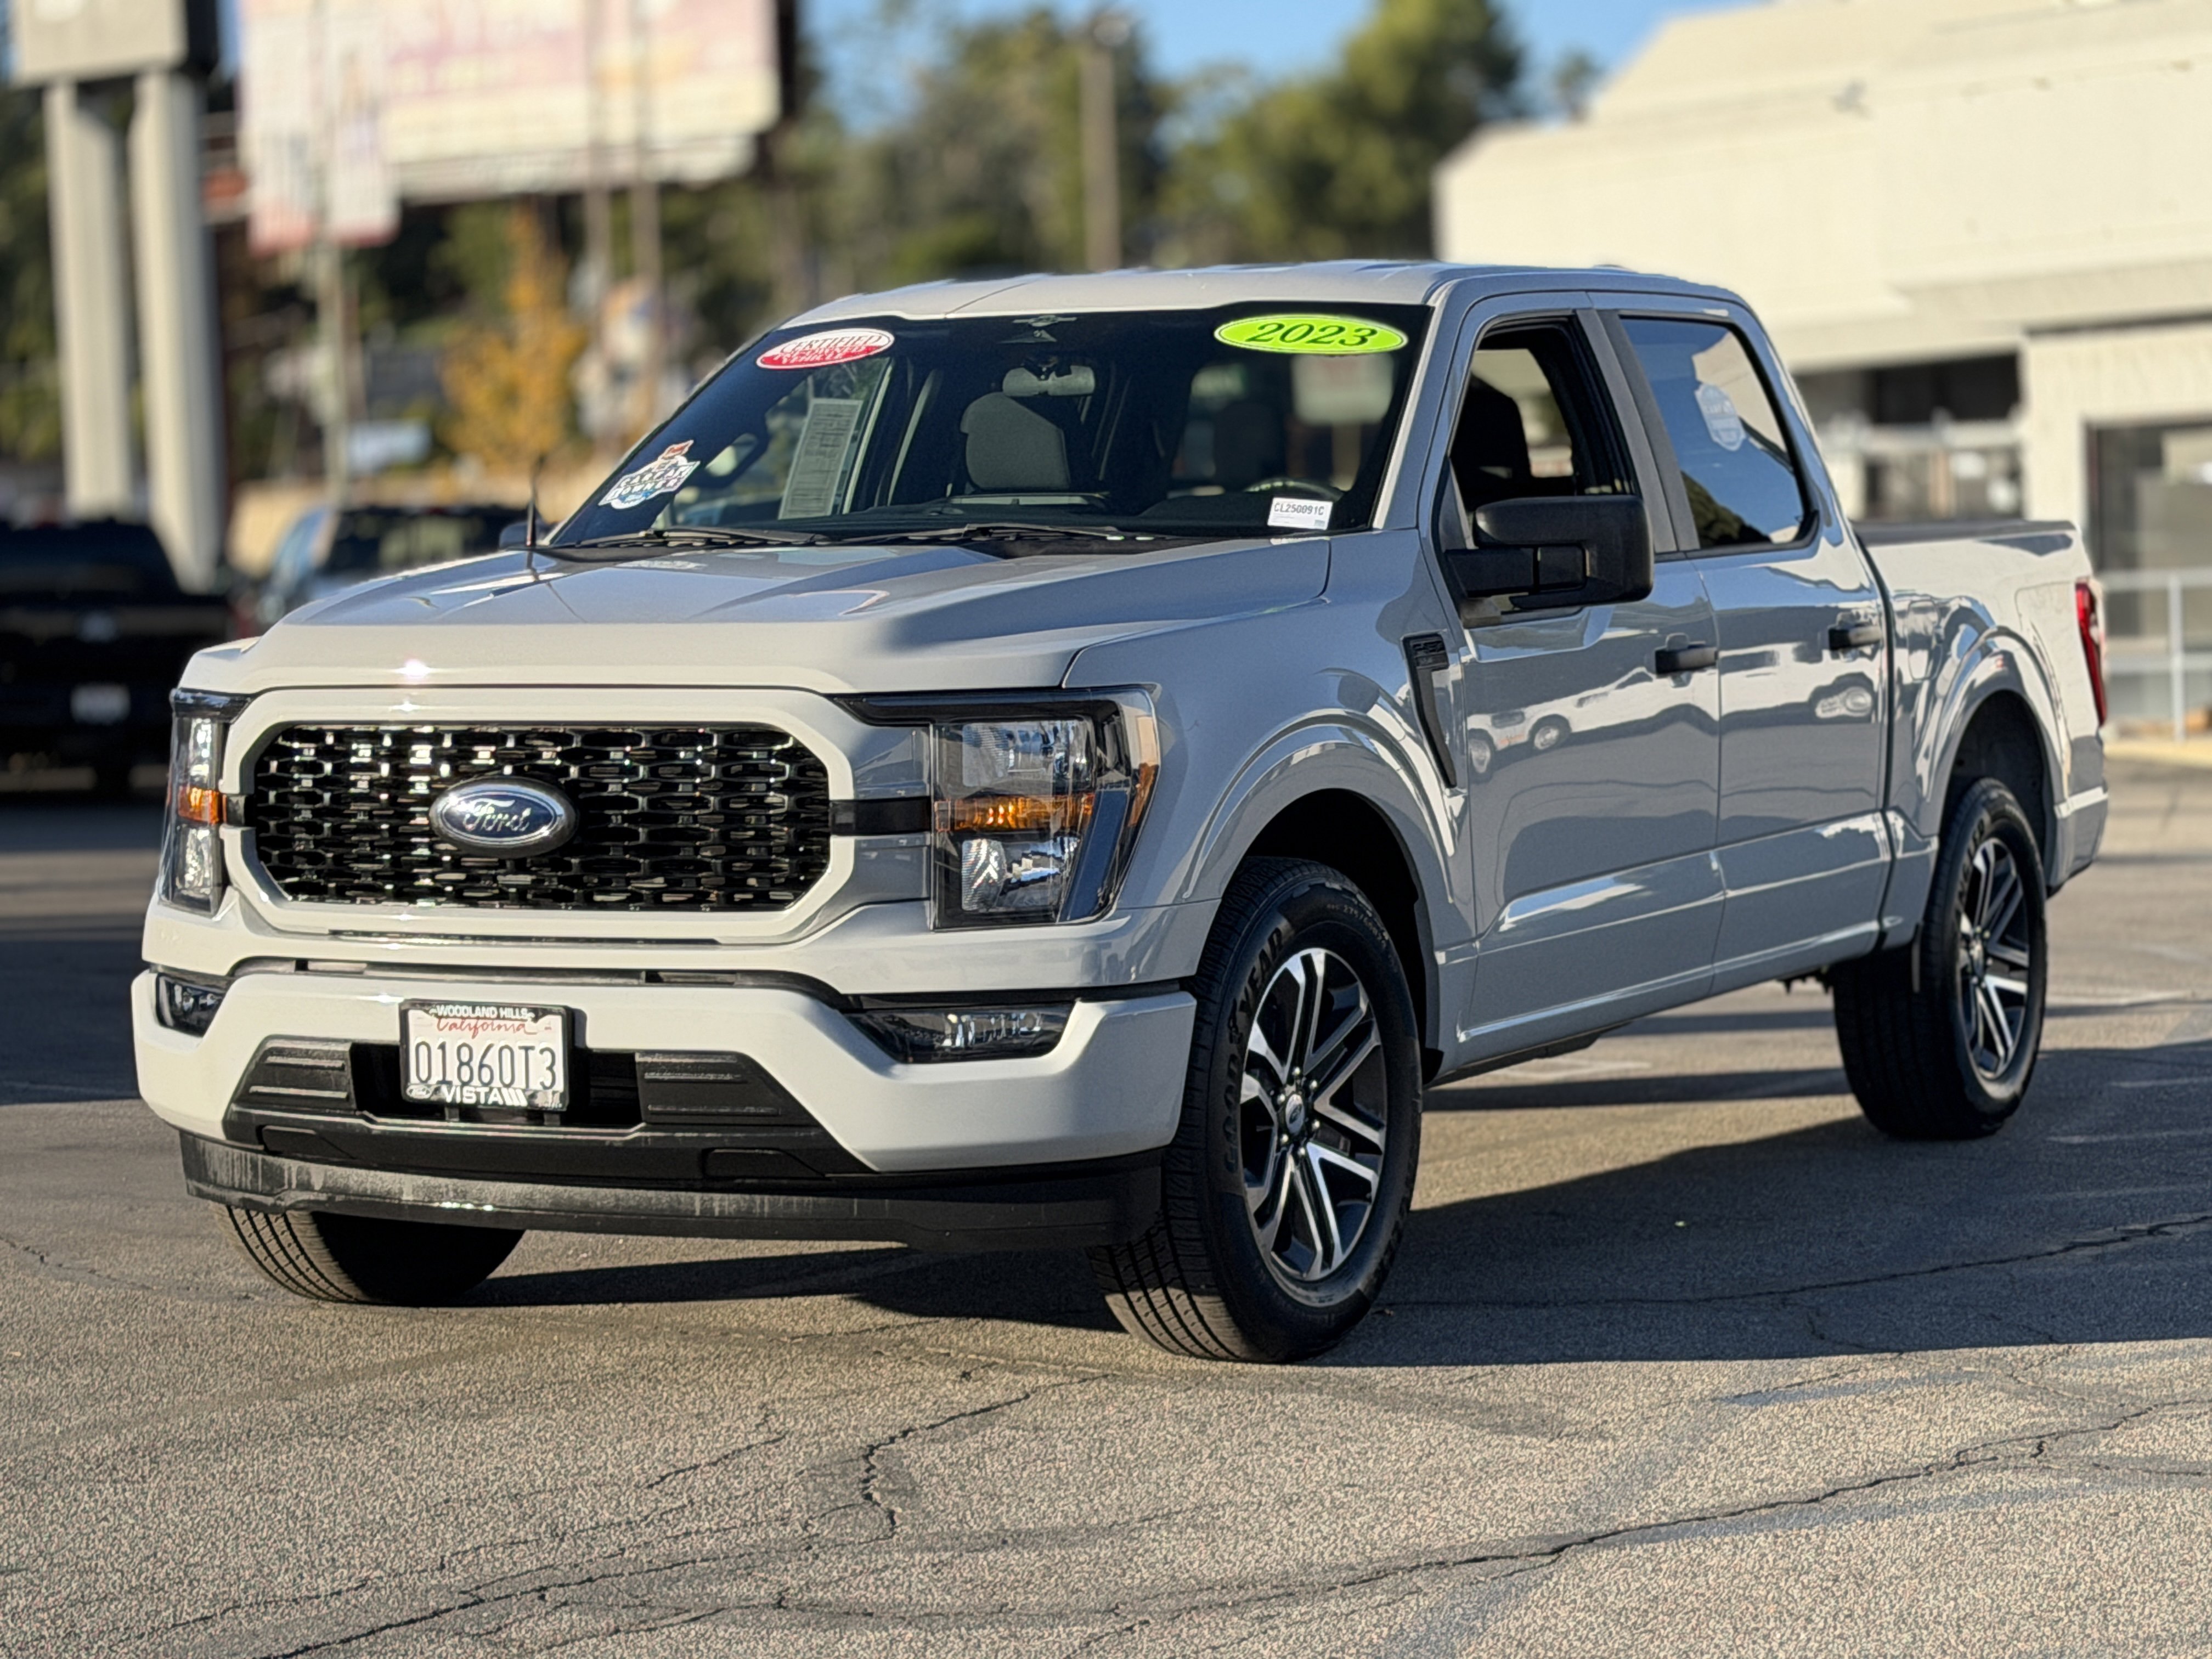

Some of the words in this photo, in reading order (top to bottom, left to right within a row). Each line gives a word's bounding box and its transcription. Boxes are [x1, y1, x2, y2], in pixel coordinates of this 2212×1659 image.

[780, 335, 883, 353] CERTIFIED
[1245, 322, 1378, 347] 2023
[456, 798, 532, 832] Ford
[437, 1005, 498, 1019] WOODLAND
[500, 1007, 528, 1019] HILLS
[436, 1018, 538, 1040] California
[415, 1040, 556, 1091] 01860T3
[441, 1085, 505, 1105] VISTA
